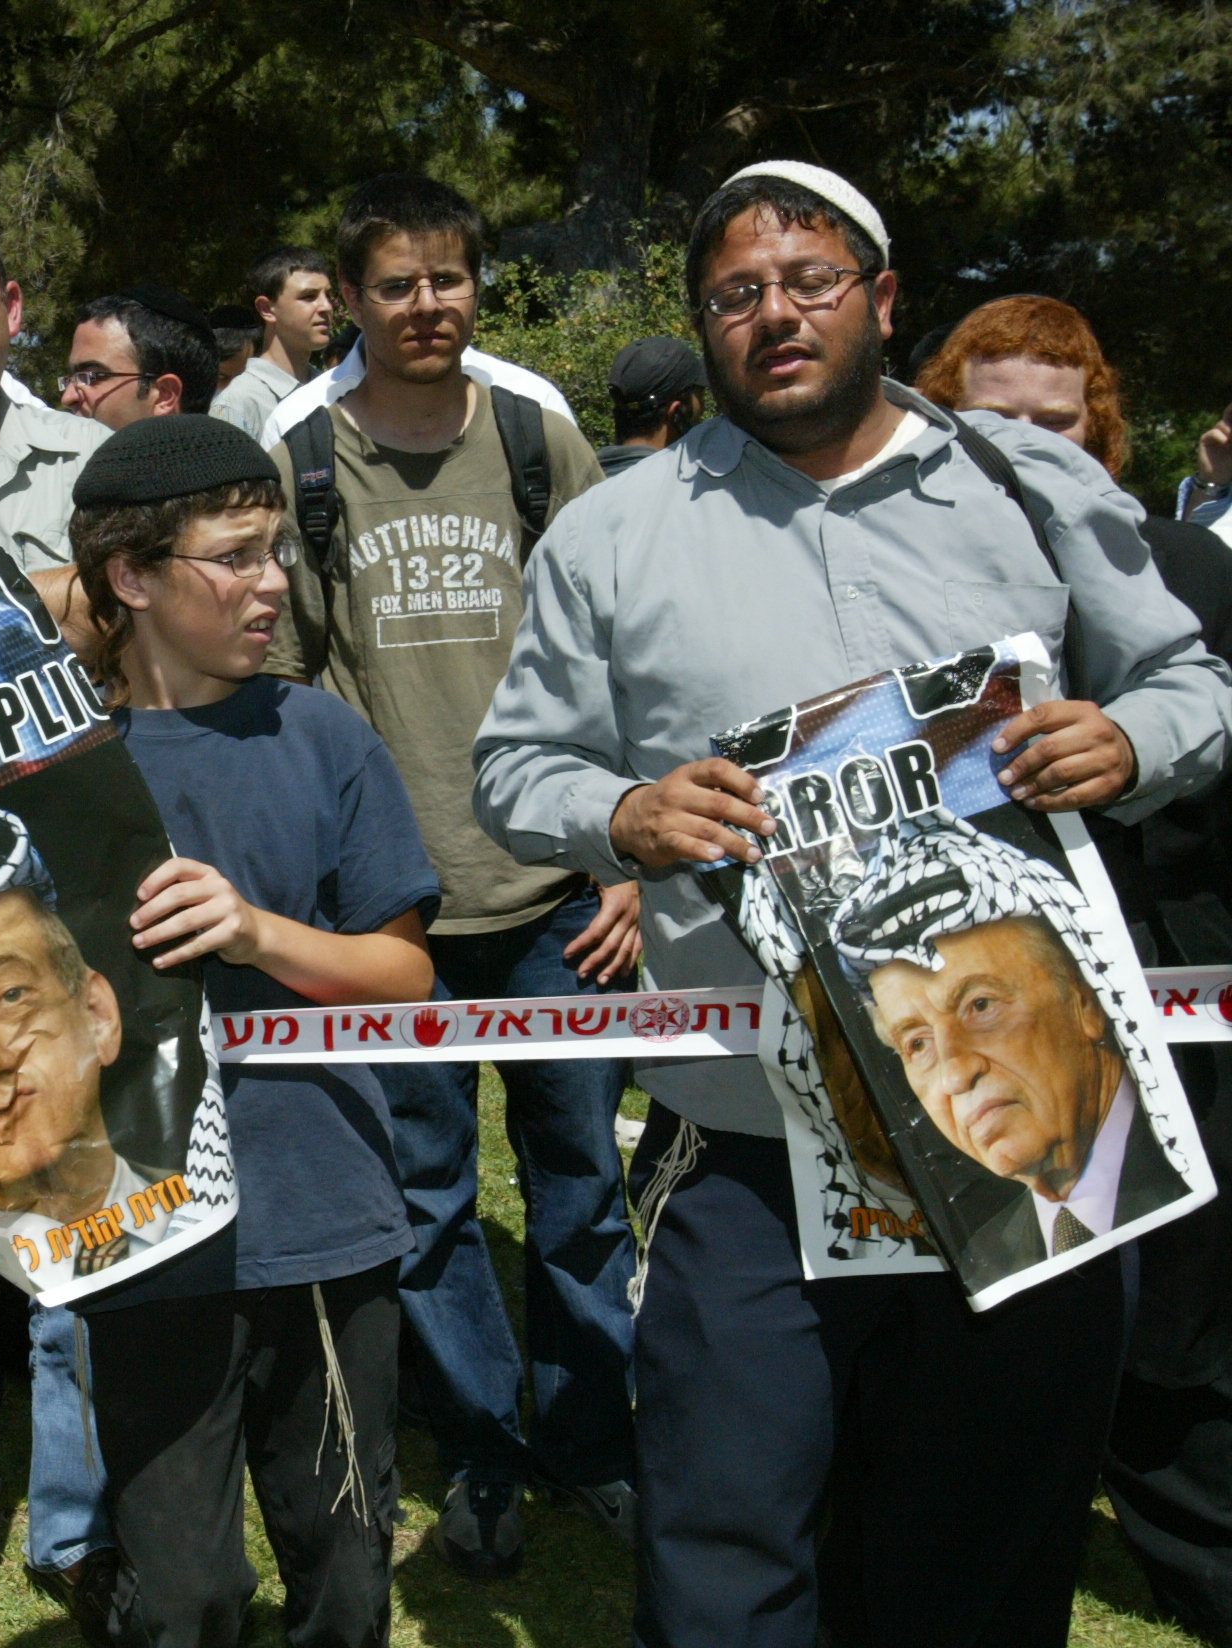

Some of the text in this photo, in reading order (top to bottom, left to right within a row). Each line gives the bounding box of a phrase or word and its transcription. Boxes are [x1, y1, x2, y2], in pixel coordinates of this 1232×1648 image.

[388, 553, 484, 592] 13-22
[371, 588, 503, 614] FOX MEN BRAND
[760, 739, 943, 860] RROR
[221, 1012, 393, 1051] אין מע
[466, 1003, 628, 1038] ישראל
[127, 1173, 193, 1229] חזית
[46, 1202, 125, 1263] יהודית
